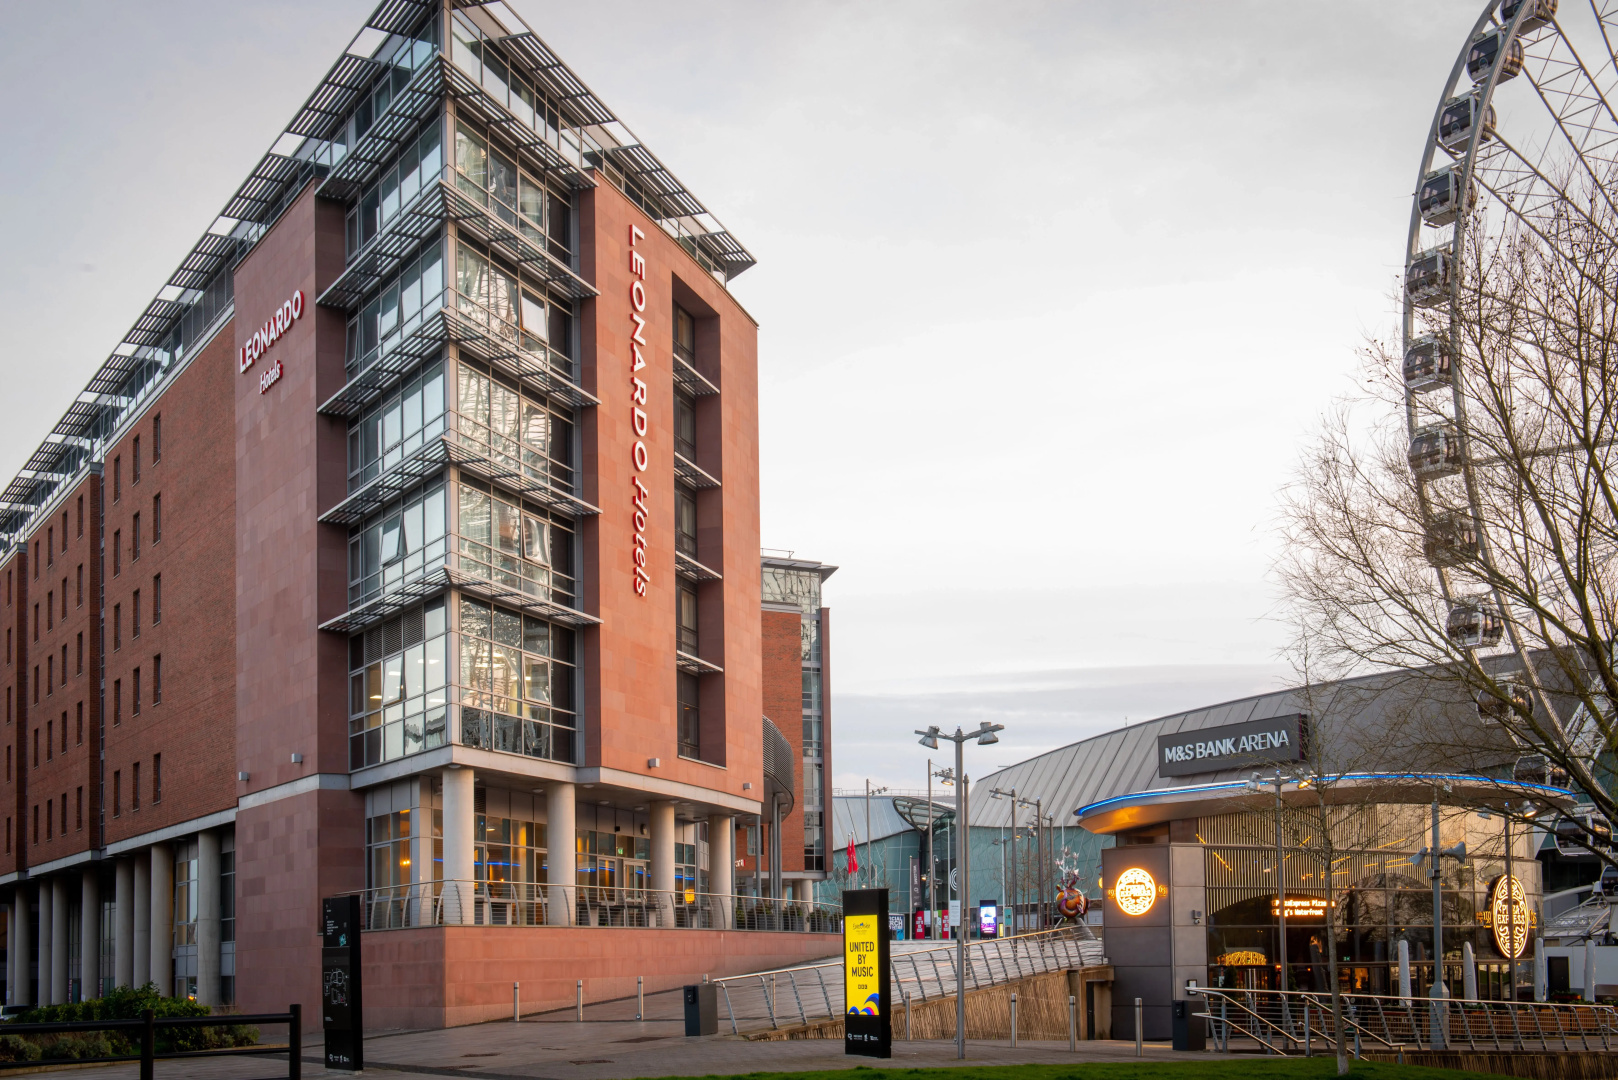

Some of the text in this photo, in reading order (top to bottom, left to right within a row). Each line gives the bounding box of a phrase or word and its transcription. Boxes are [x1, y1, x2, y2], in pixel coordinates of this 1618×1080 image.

[239, 289, 304, 374] LEONARDO
[259, 359, 283, 394] Hotels
[628, 223, 649, 597] LEONARDO Hotels
[1164, 729, 1290, 763] M&S BANK ARENA
[1275, 899, 1310, 908] PzaExpress
[1275, 908, 1293, 917] Kg's
[1501, 904, 1520, 915] PIZA
[1497, 914, 1525, 925] EXPESS
[849, 941, 875, 953] UNITED
[857, 954, 867, 965] BY
[851, 966, 874, 977] MUSIC
